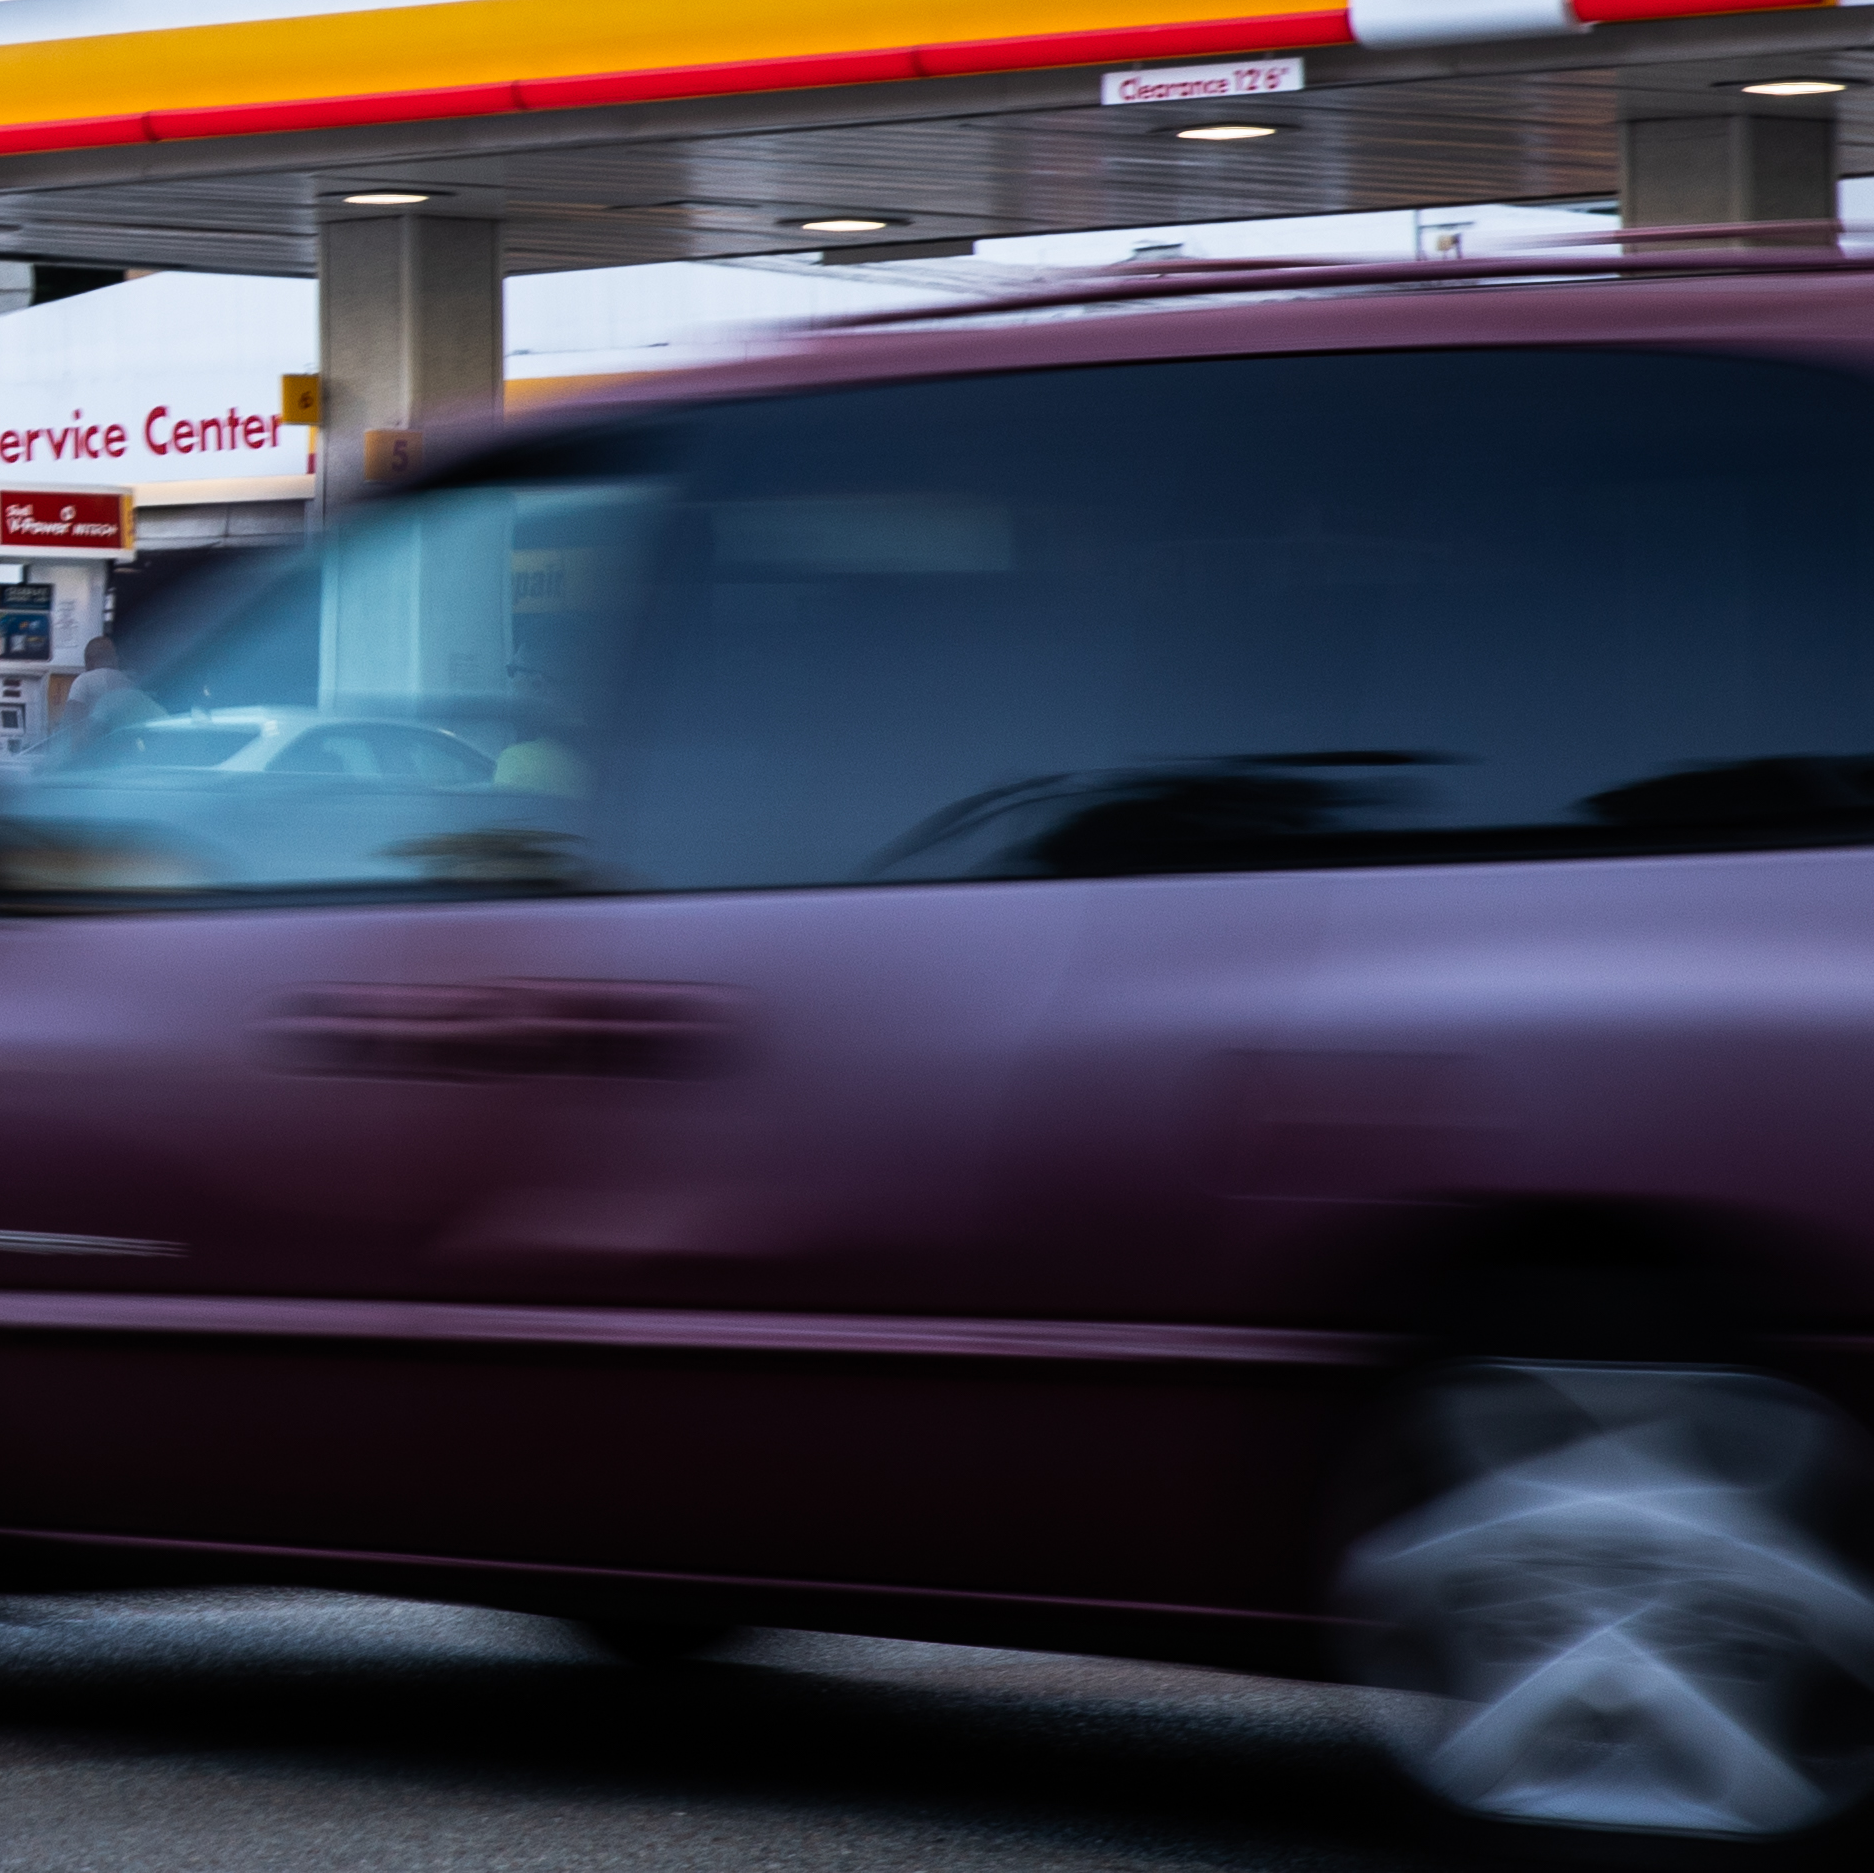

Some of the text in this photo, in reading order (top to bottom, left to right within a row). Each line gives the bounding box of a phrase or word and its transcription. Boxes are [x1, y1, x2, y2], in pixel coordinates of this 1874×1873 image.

[1120, 76, 1229, 102] Clearance
[144, 406, 283, 457] Center
[391, 439, 409, 473] 5
